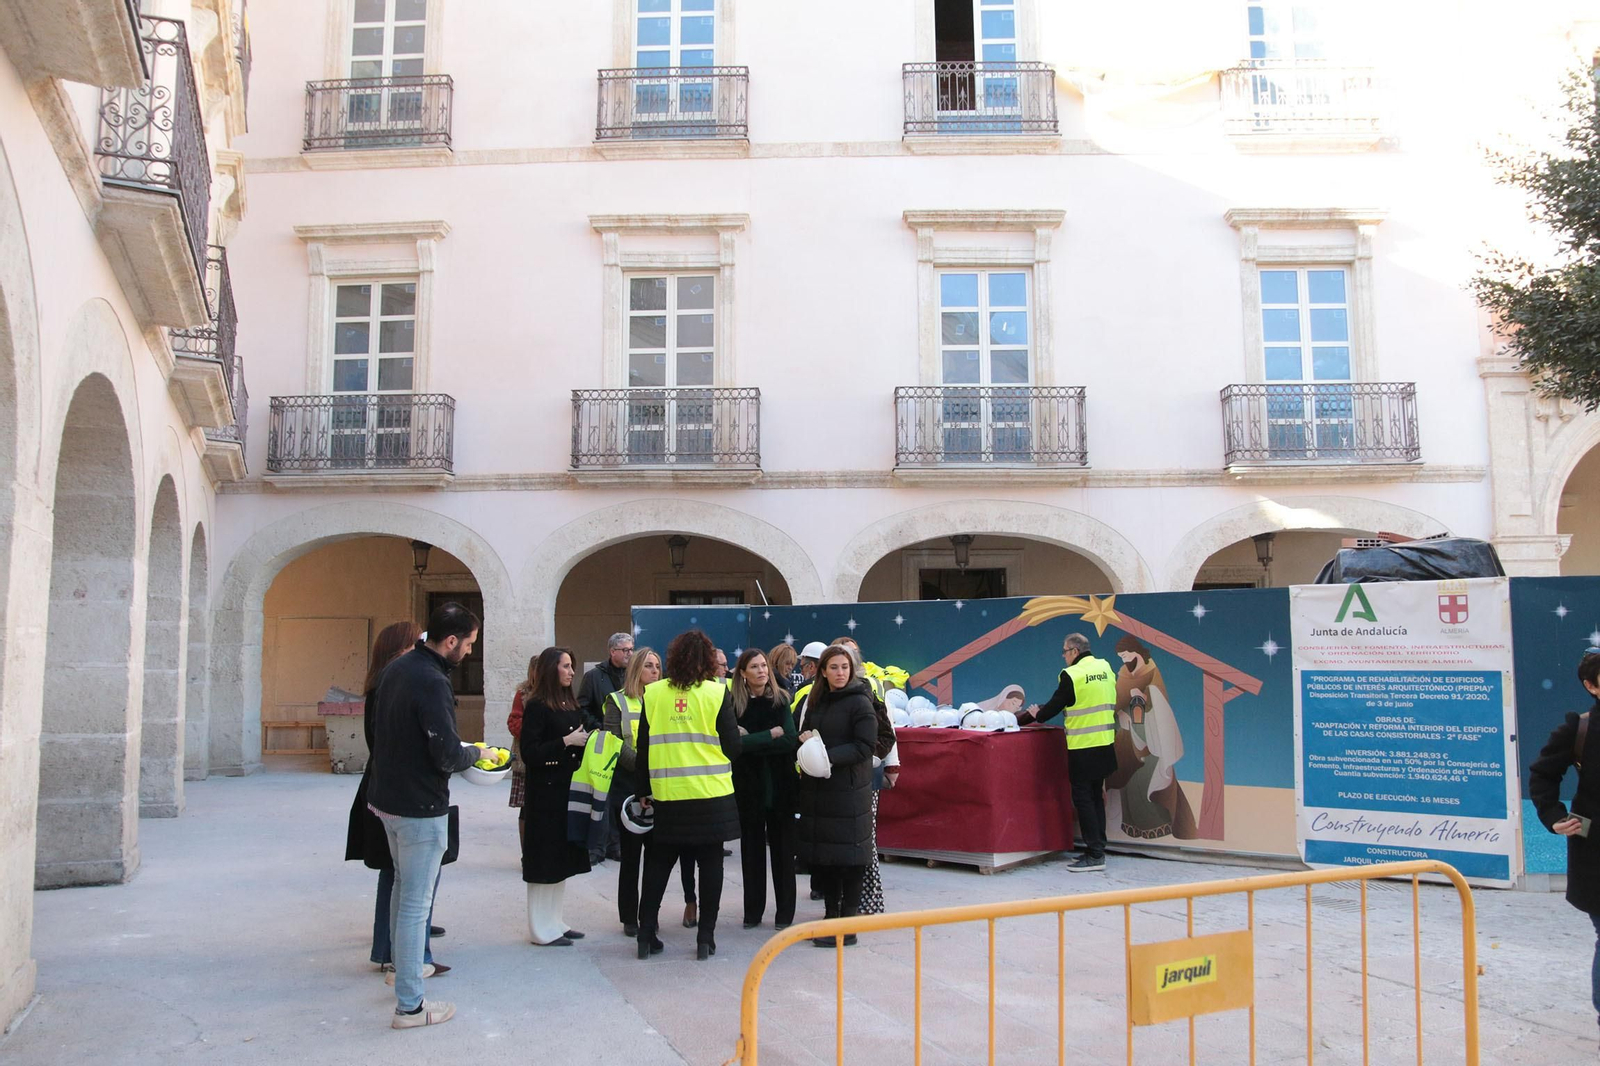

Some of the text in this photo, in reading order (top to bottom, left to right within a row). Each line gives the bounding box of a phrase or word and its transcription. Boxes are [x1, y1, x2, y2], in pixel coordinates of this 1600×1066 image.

[1310, 626, 1407, 636] Junta de Andalucía
[1343, 764, 1400, 772] Infraestructuras
[1376, 794, 1418, 802] EJECUCIÓN:
[1312, 812, 1500, 842] Construyendo Almería
[1366, 847, 1428, 858] CONSTRUCTORA
[1161, 957, 1211, 988] jarquil
